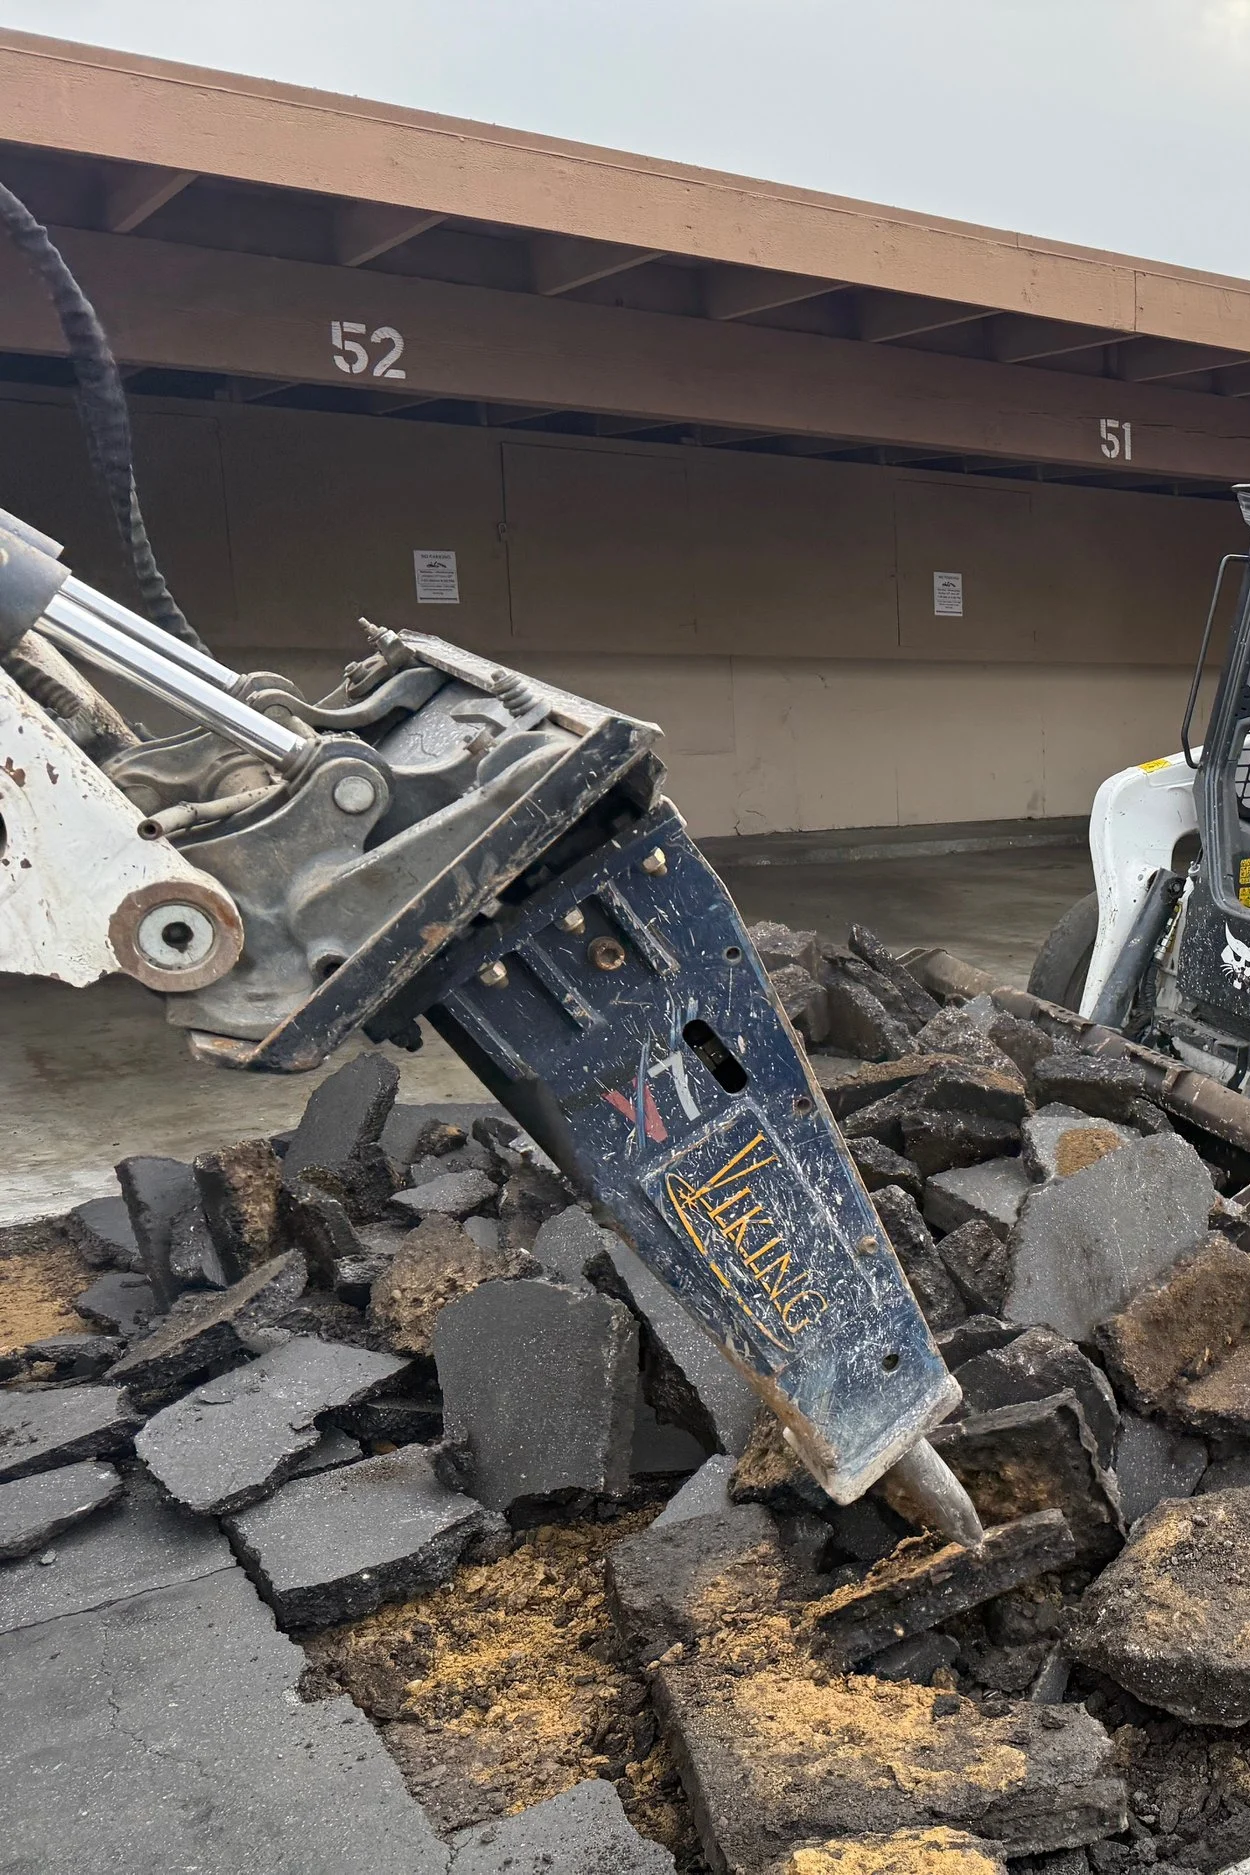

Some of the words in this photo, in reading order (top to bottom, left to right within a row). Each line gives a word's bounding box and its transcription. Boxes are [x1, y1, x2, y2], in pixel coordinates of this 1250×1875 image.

[331, 320, 406, 379] 52
[1099, 418, 1132, 461] 51
[678, 1130, 829, 1334] VIKING
